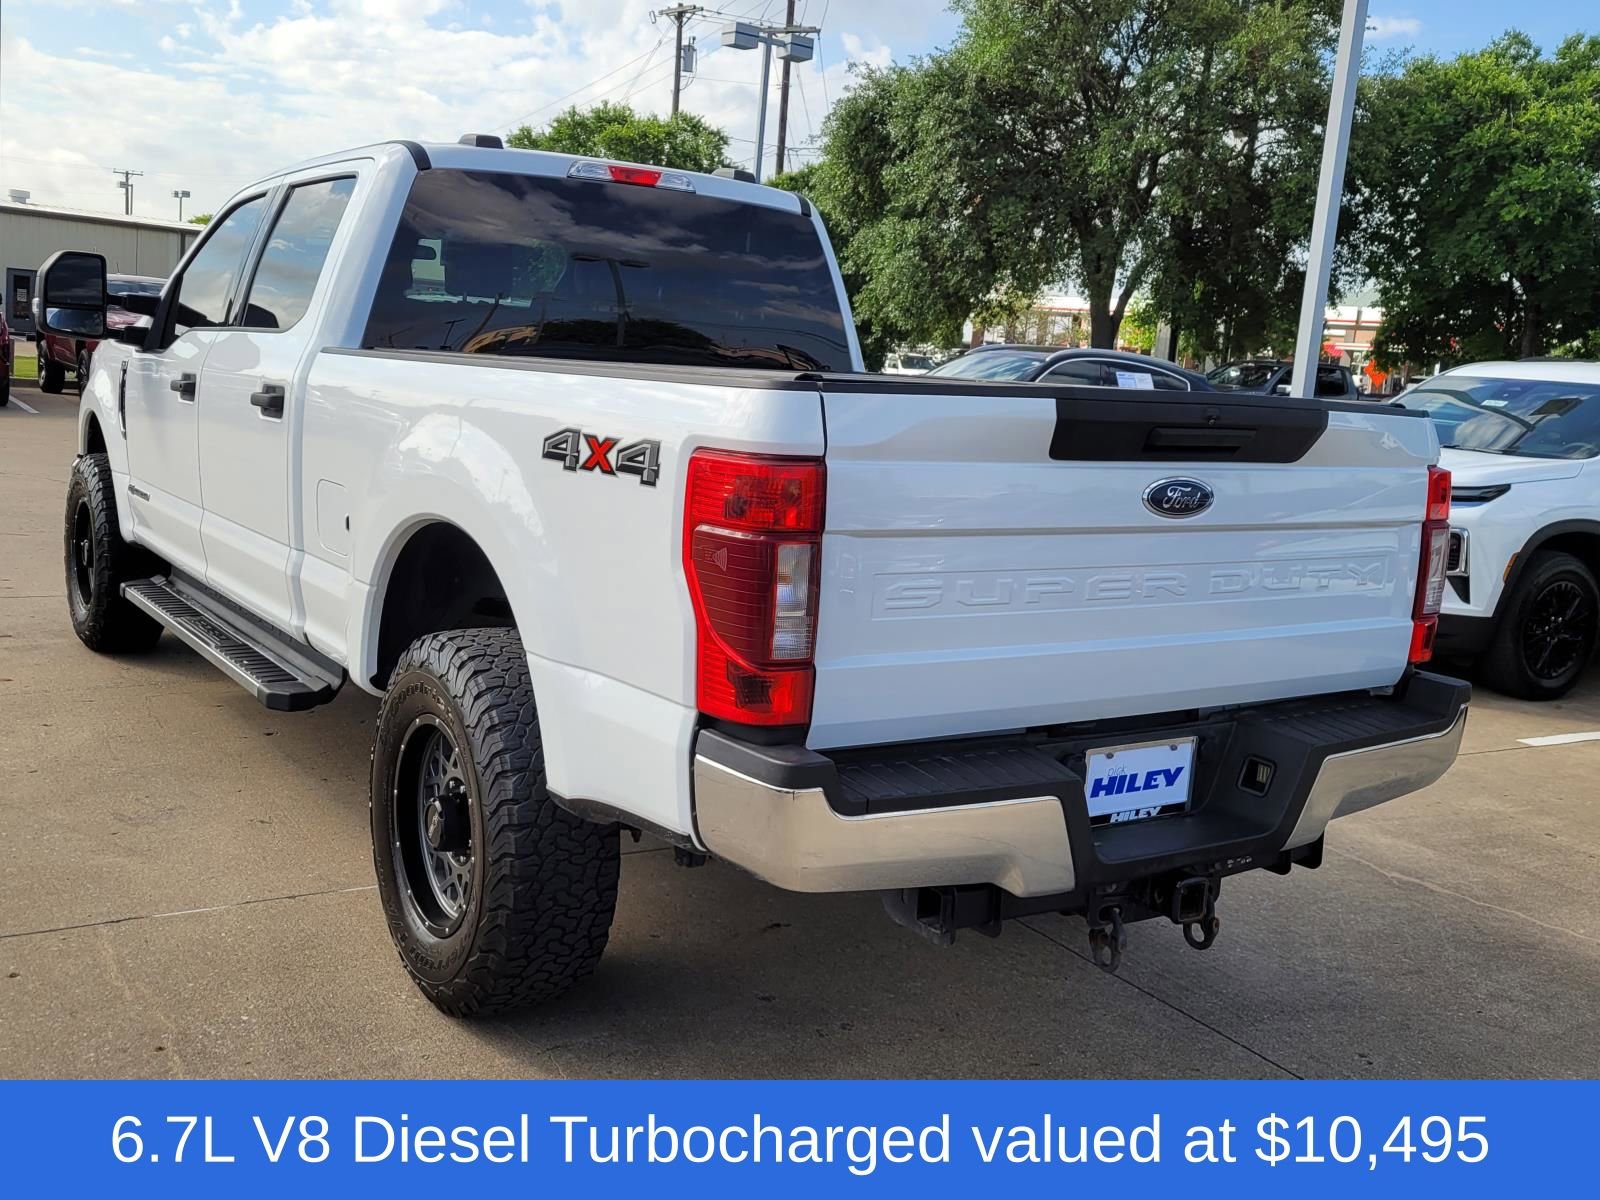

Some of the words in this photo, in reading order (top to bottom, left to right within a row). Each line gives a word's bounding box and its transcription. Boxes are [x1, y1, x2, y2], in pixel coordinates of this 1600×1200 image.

[1162, 485, 1201, 508] Ford
[884, 569, 1187, 610] SUPER
[1208, 560, 1384, 595] DUTY
[1090, 766, 1185, 798] HILEY
[1110, 806, 1162, 823] HILEY
